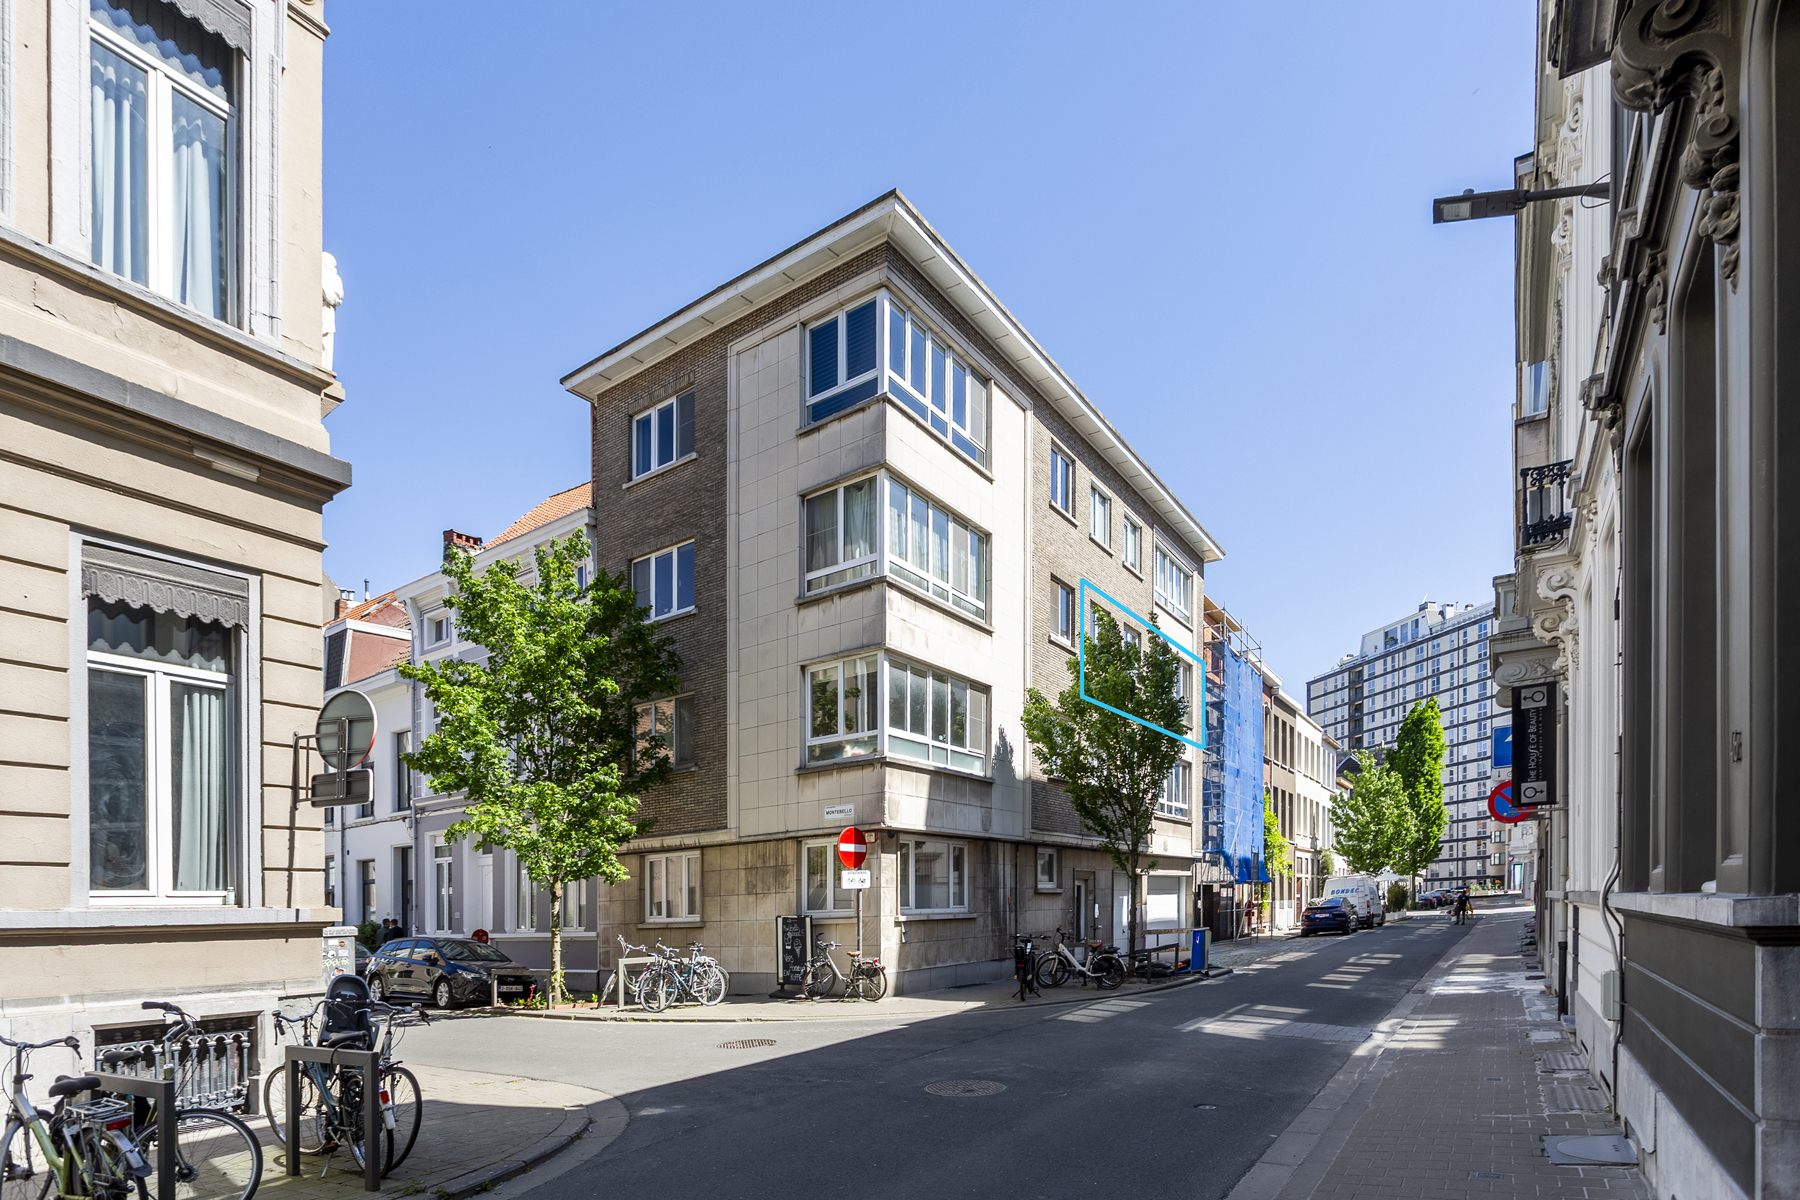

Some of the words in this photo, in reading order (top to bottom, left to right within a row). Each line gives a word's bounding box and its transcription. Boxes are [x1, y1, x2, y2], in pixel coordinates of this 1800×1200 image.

[1528, 709, 1537, 733] BEAUTY
[1529, 734, 1537, 743] OF
[1528, 744, 1539, 769] HOUSE
[1528, 770, 1537, 782] THE
